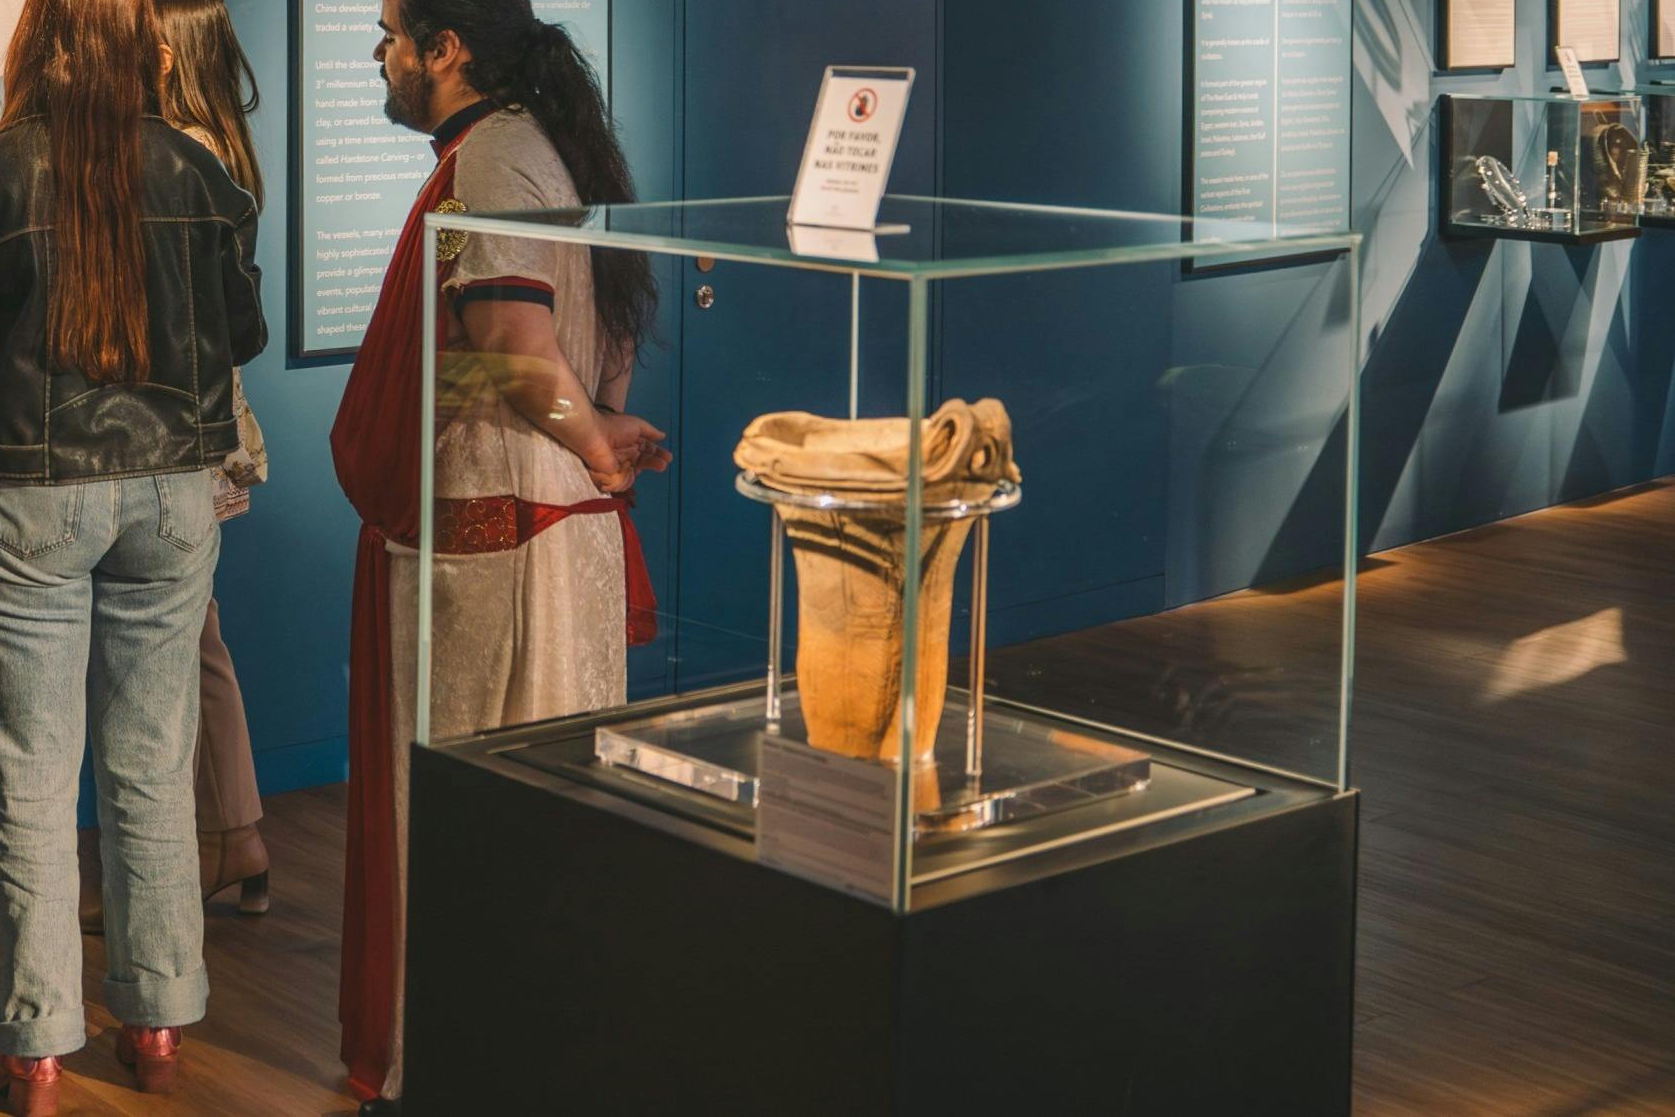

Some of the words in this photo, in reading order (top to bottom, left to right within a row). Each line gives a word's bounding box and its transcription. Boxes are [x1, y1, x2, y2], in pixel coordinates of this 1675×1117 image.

[316, 155, 338, 164] called
[339, 153, 379, 163] Hardstone
[380, 152, 410, 163] Carving
[416, 153, 426, 161] or
[315, 194, 344, 204] copper
[354, 190, 382, 202] bronze.
